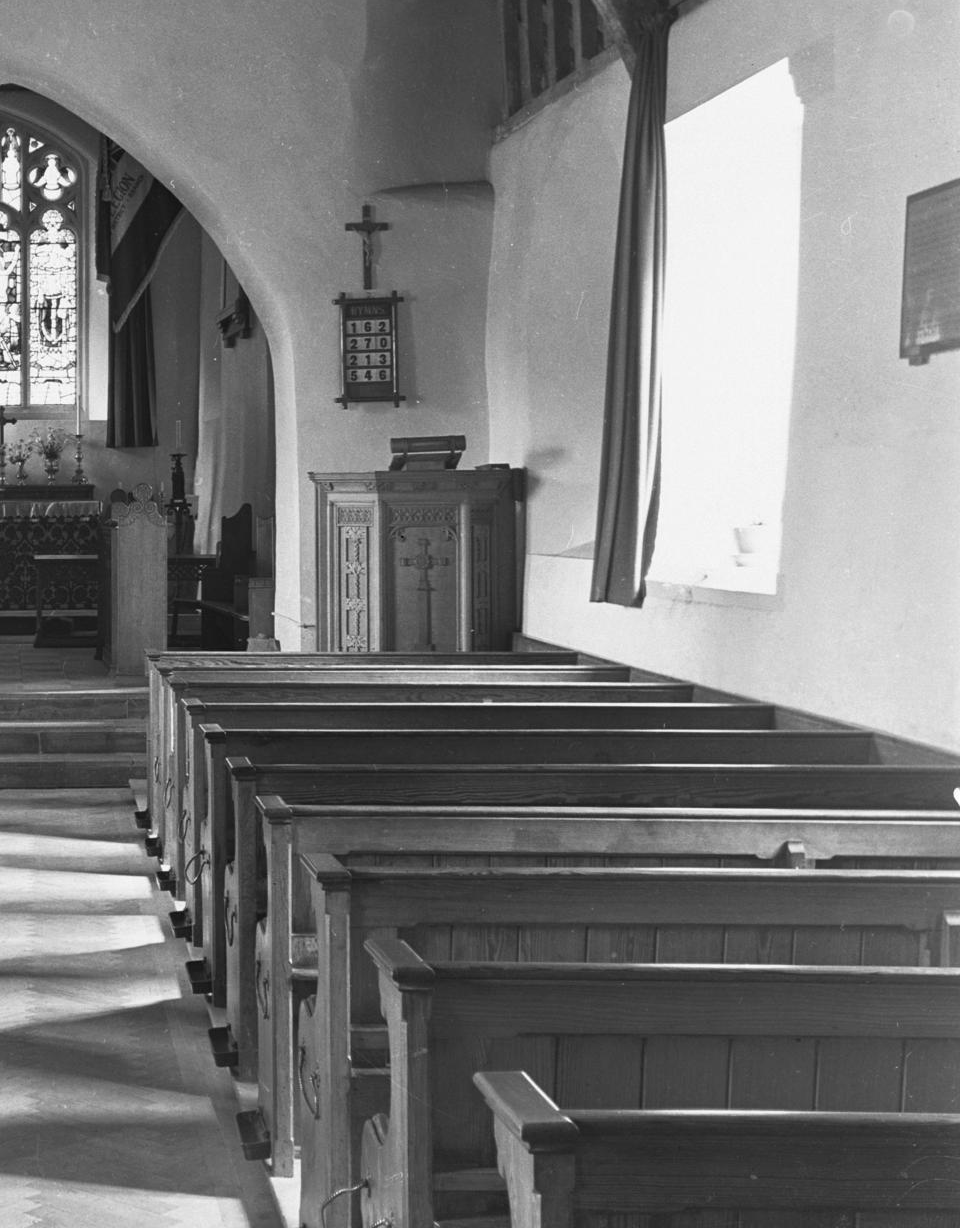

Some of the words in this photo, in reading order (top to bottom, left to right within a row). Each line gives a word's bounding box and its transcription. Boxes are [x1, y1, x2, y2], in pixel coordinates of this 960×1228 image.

[350, 321, 386, 333] 162
[350, 337, 387, 349] 270
[350, 354, 387, 366] 213
[350, 370, 387, 381] 546
